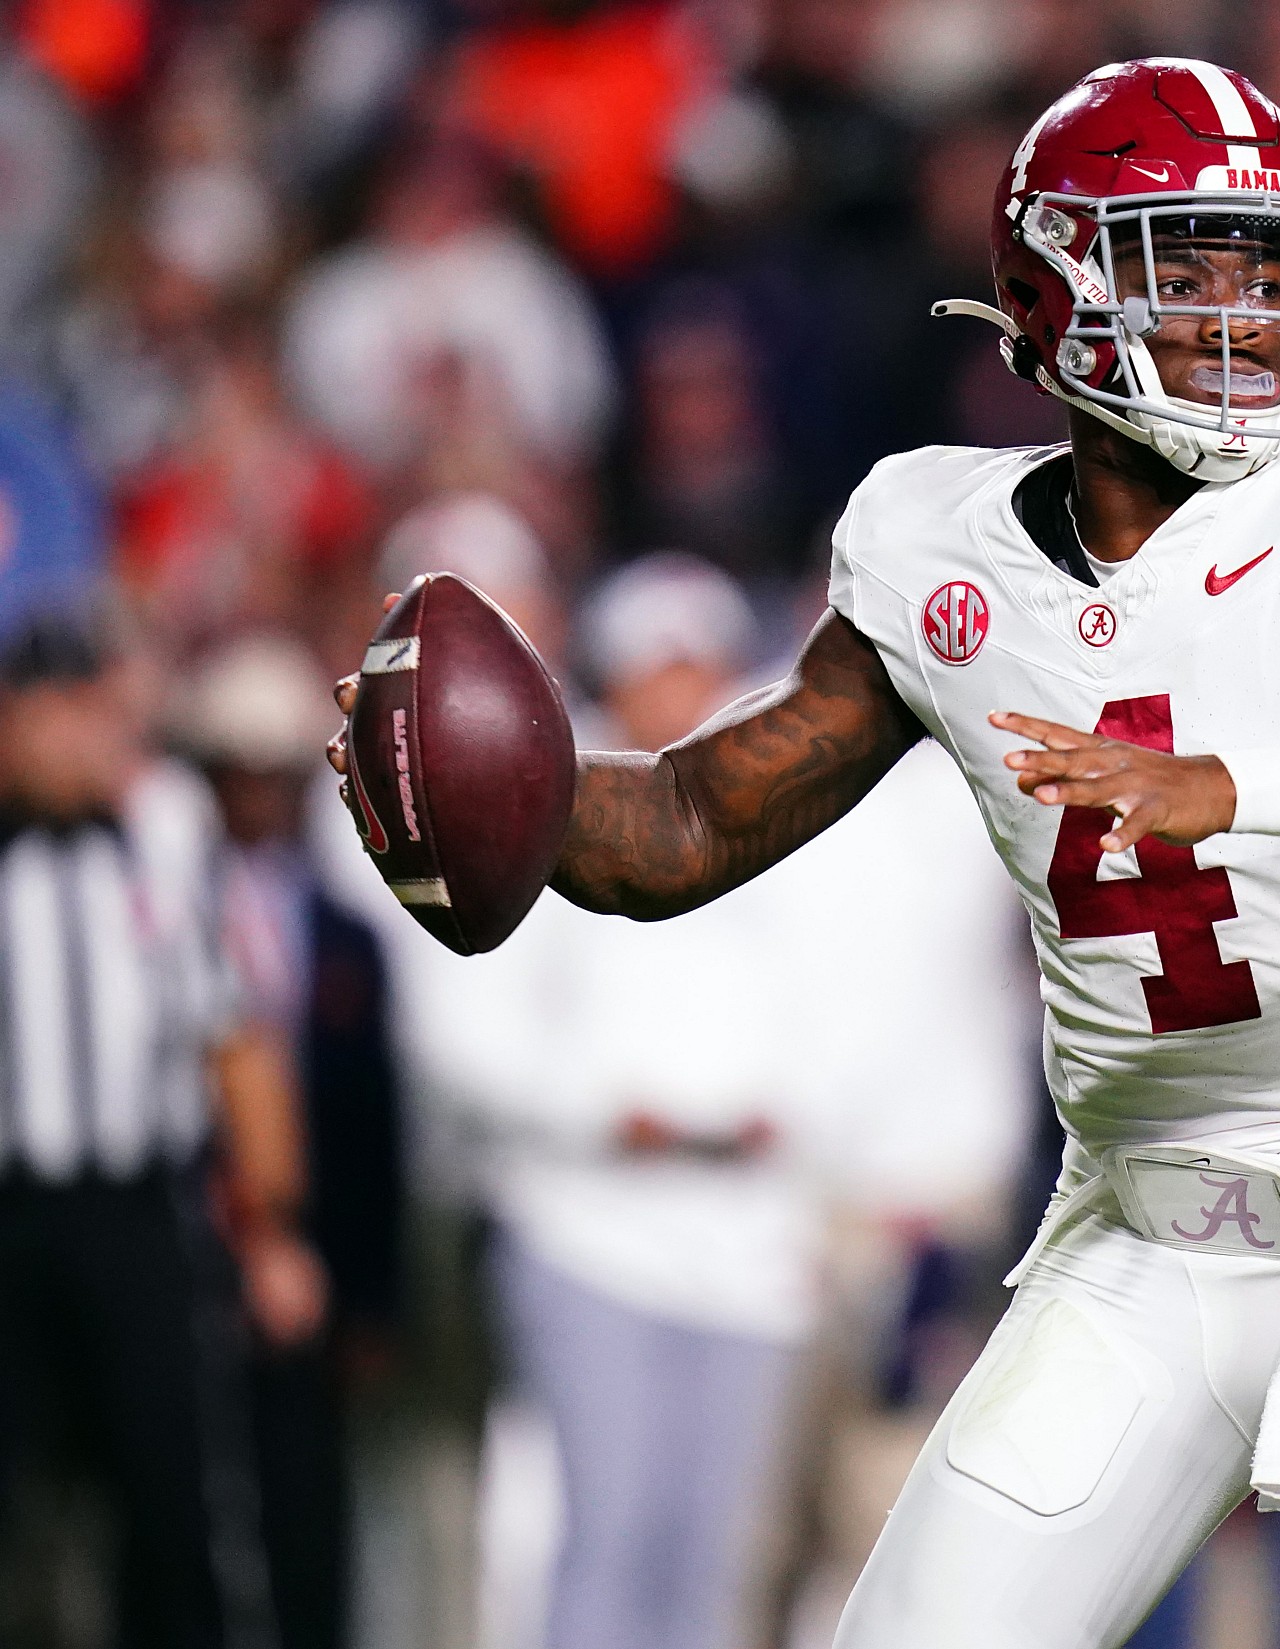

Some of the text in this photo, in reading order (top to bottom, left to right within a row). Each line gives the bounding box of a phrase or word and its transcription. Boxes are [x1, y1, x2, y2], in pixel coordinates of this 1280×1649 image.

[1011, 105, 1056, 194] 4
[1226, 169, 1280, 192] BAMA
[1087, 283, 1109, 305] TID
[925, 585, 986, 659] SEC
[1085, 609, 1108, 639] A
[1047, 693, 1262, 1034] 4
[1171, 1173, 1275, 1249] A
